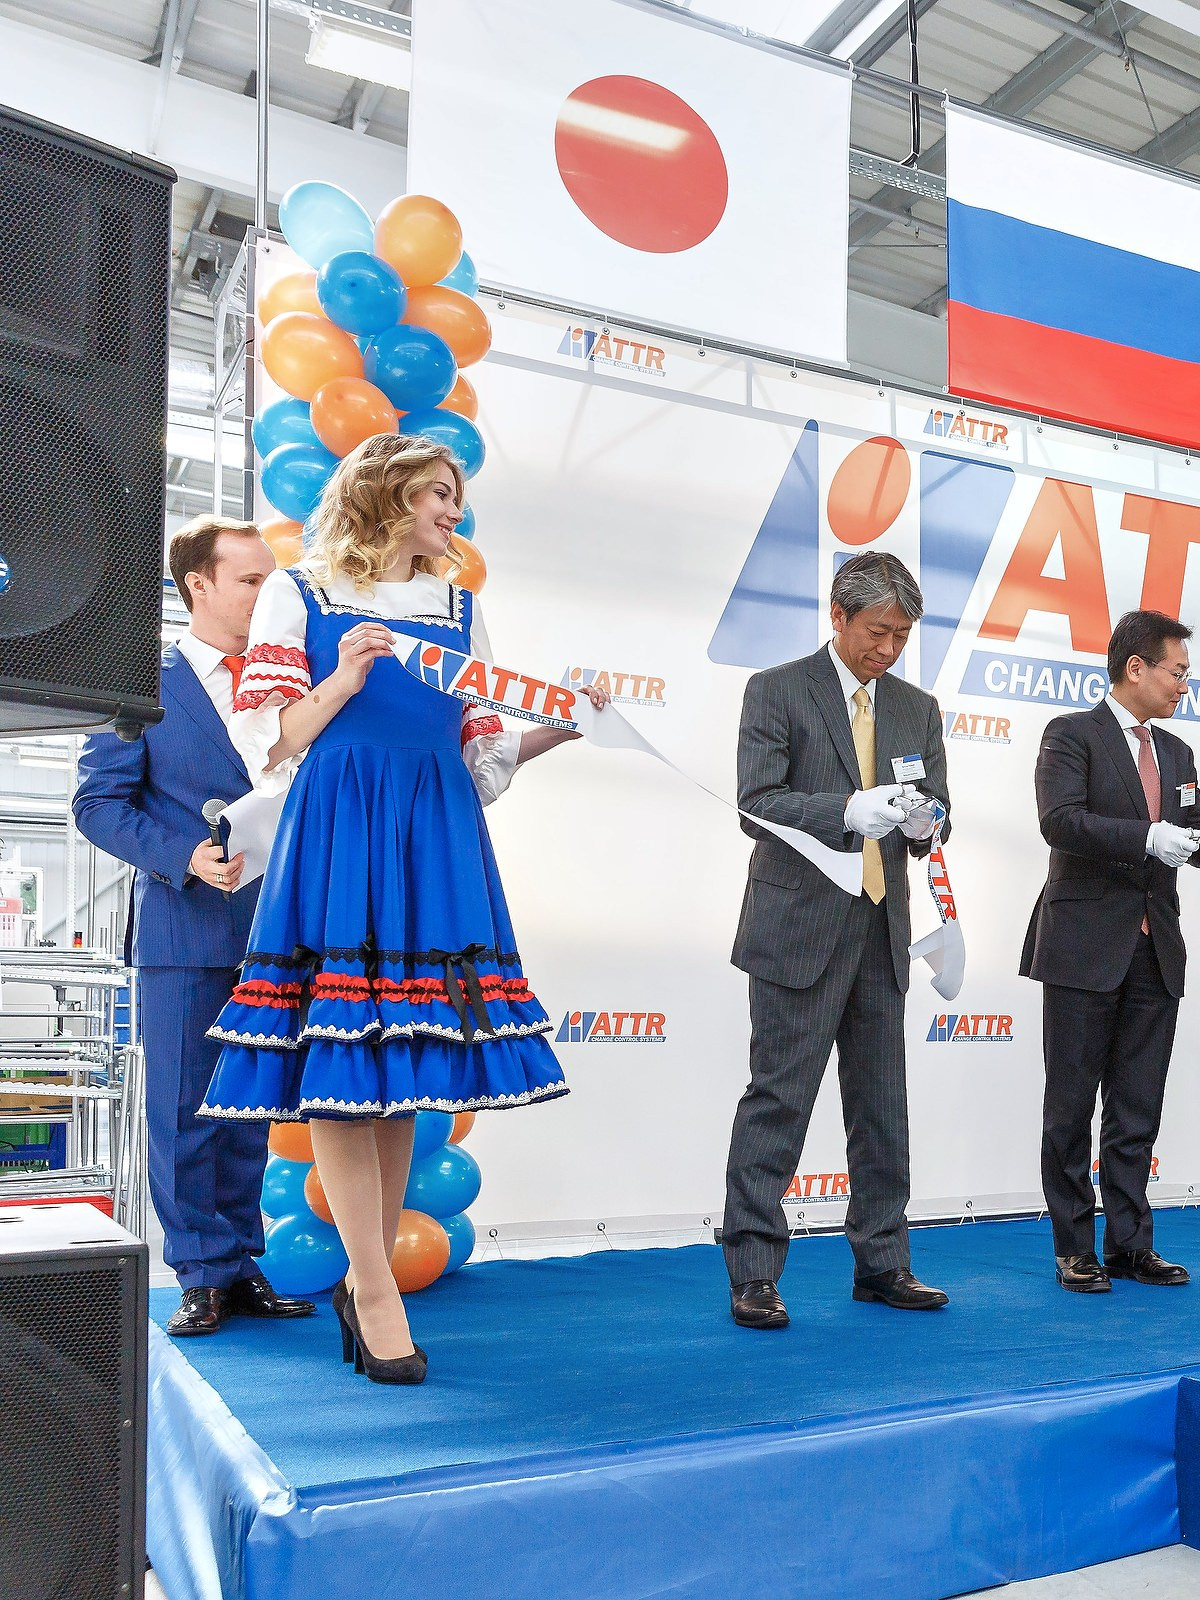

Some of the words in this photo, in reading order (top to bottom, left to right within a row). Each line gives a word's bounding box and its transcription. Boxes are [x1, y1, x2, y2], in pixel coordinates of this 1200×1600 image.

[592, 334, 666, 370] ATTR
[950, 415, 1008, 445] ATTR
[455, 659, 576, 720] ATTR
[594, 671, 666, 700] ATTR
[984, 660, 1105, 704] CHANG
[456, 691, 491, 708] CHANGE
[492, 704, 532, 720] CONTROL
[533, 714, 573, 729] SYSTEMS
[952, 713, 1010, 738] ATTR
[930, 847, 956, 920] TTR
[590, 1012, 666, 1035] ATTR
[954, 1015, 1013, 1035] ATTR
[784, 1173, 850, 1197] ATTR
